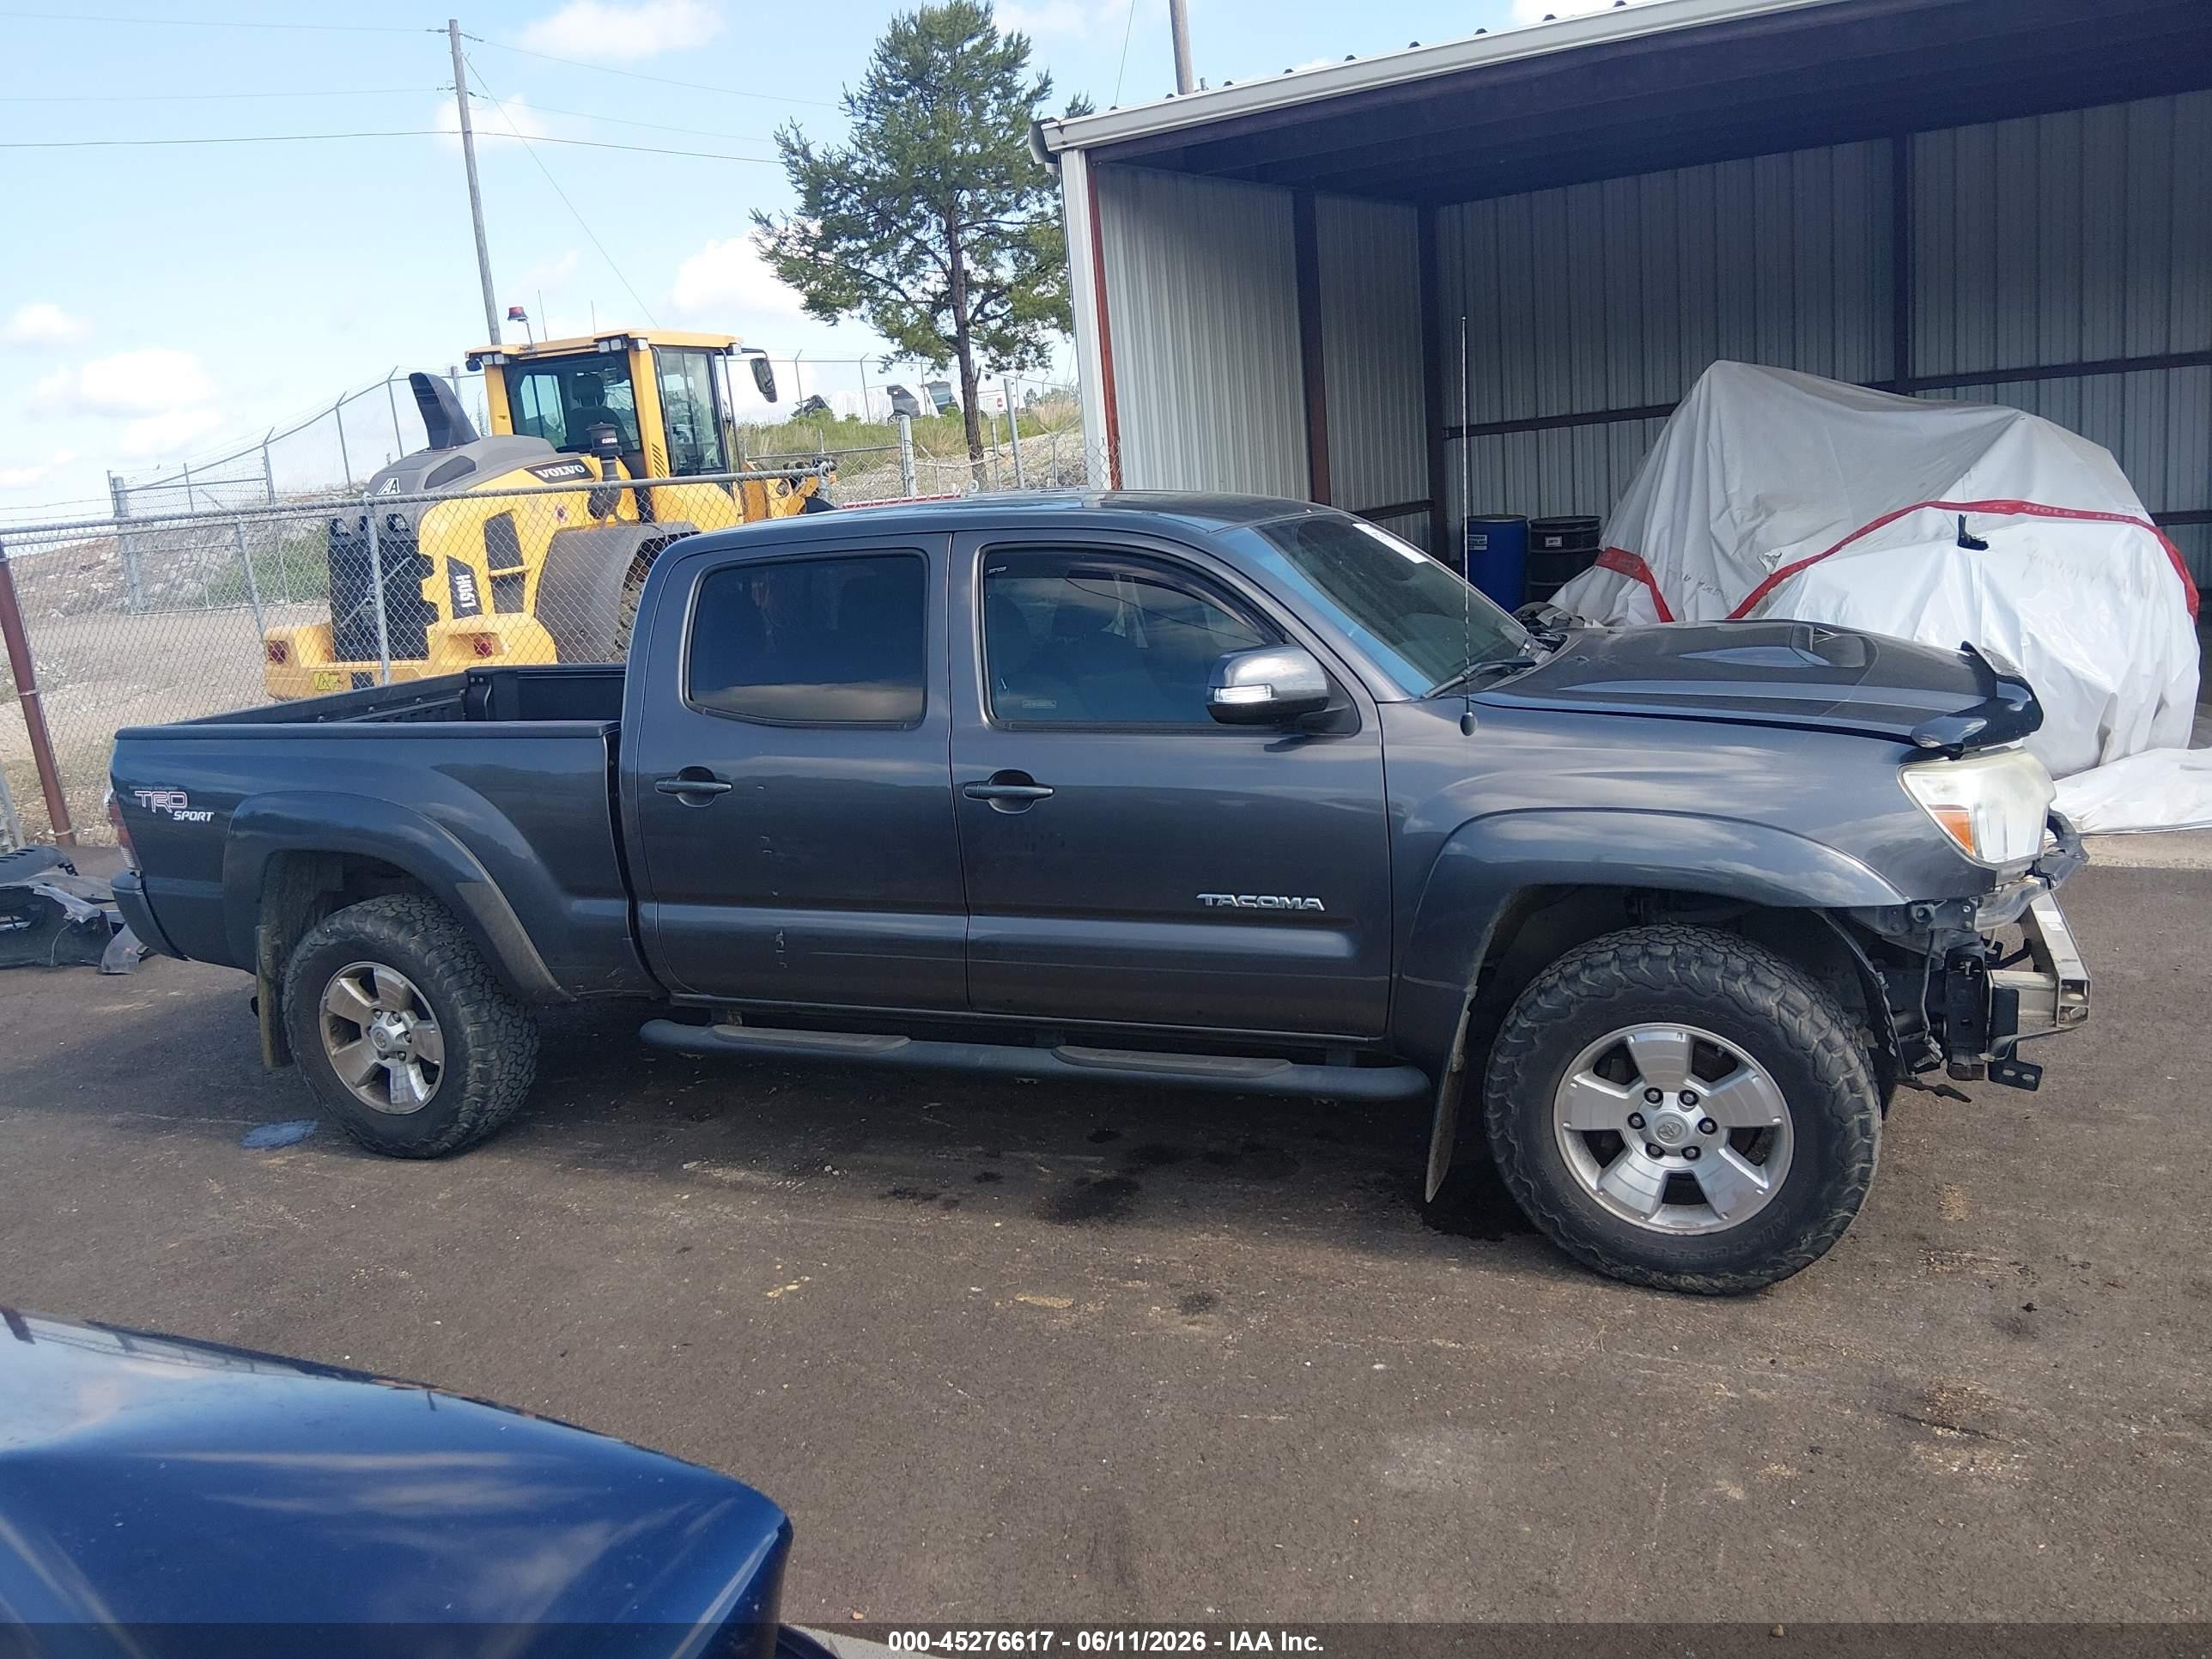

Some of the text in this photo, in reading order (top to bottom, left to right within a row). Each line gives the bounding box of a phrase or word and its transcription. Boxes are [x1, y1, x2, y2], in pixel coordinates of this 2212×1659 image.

[535, 465, 586, 478] VOLVO
[134, 790, 188, 813] TRD
[173, 811, 215, 822] SPORT
[1196, 893, 1326, 912] TACOMA
